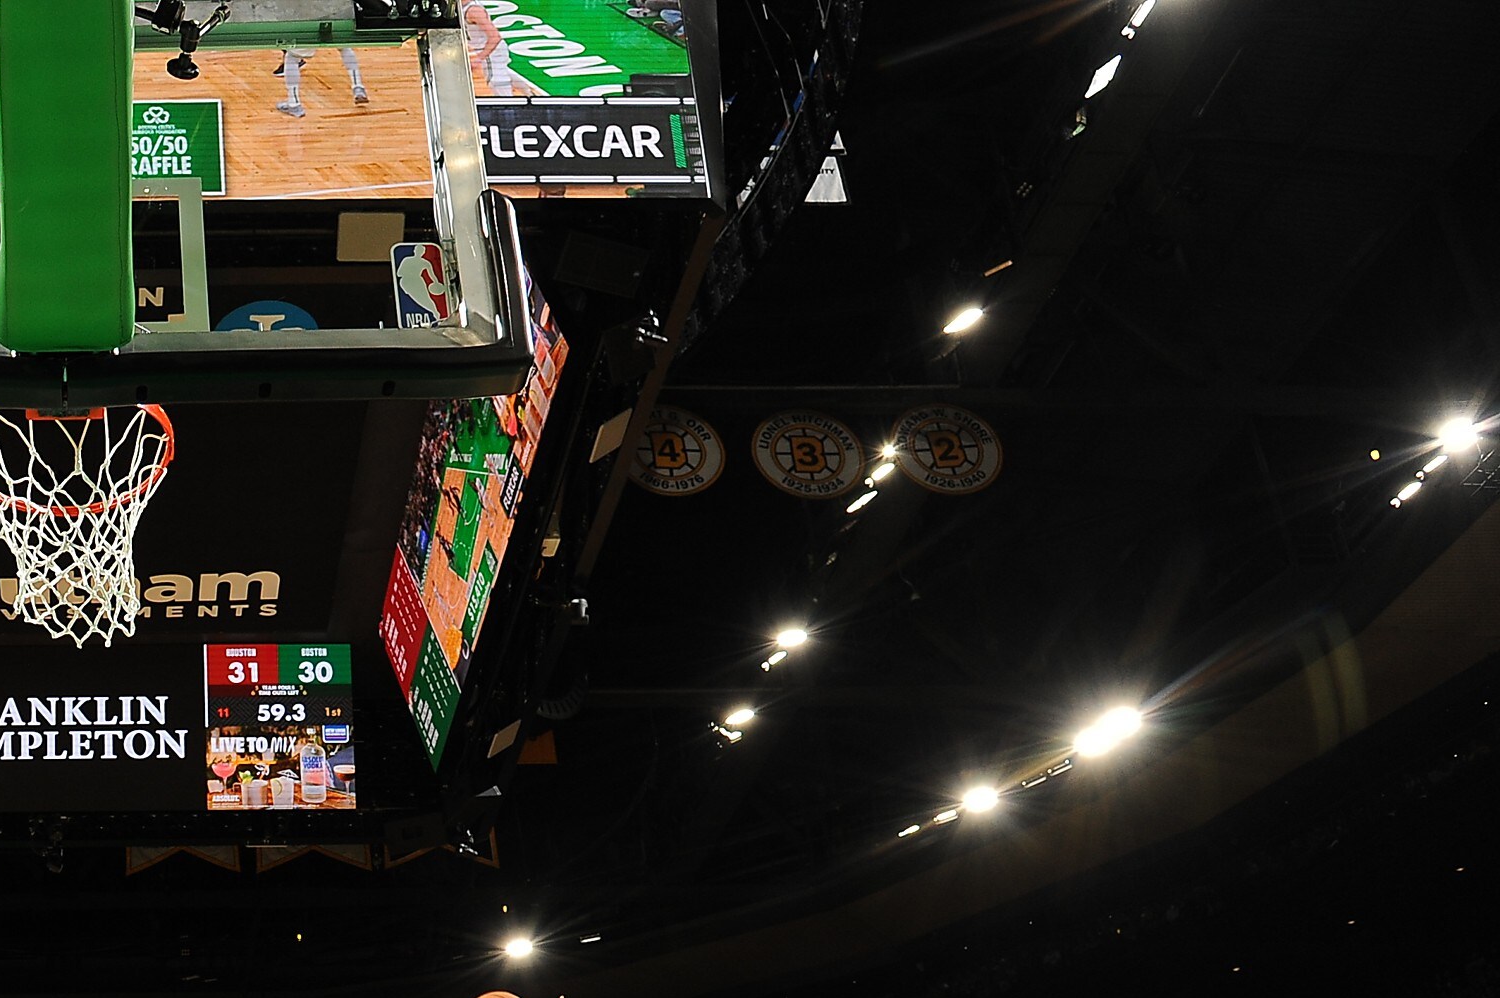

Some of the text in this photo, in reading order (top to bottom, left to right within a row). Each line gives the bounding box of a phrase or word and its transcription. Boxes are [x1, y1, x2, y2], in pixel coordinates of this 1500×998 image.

[686, 419, 711, 442] ORR
[759, 415, 854, 451] LIONEL HITCHMAN
[954, 412, 993, 445] SHORE
[658, 439, 680, 462] 4
[796, 442, 816, 466] 3
[936, 438, 958, 461] 2
[226, 648, 327, 657] HOUSTON BOSTON
[227, 661, 333, 683] 31 30
[217, 704, 342, 722] 11 59.3 1st
[210, 736, 297, 753] LIVE TO MIX
